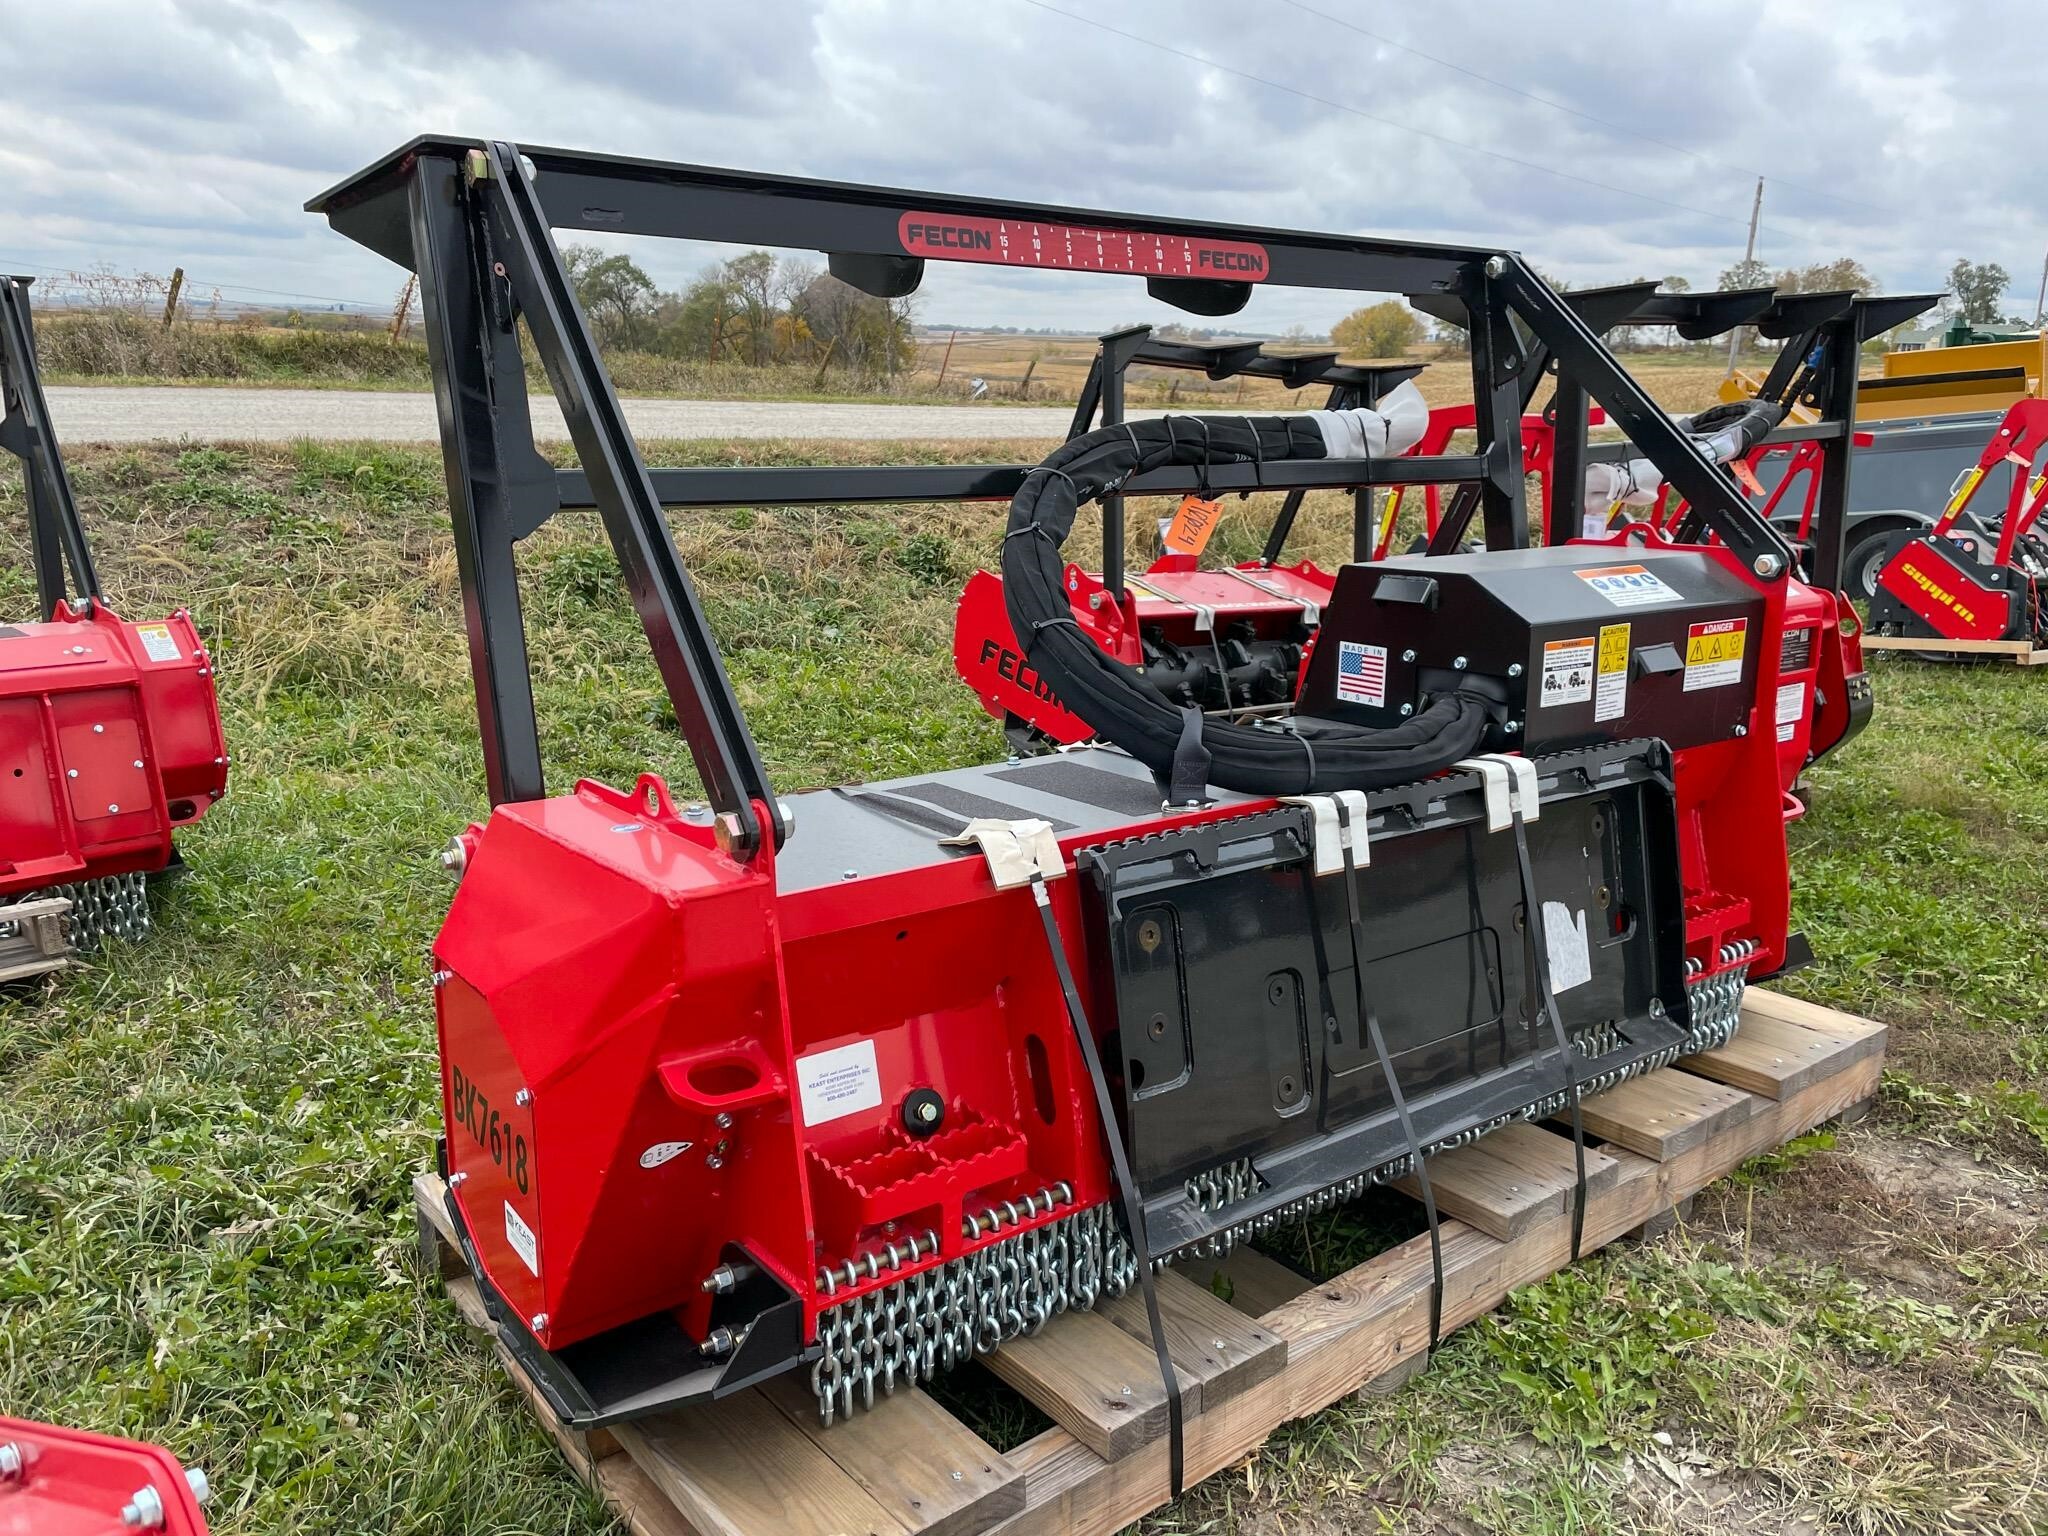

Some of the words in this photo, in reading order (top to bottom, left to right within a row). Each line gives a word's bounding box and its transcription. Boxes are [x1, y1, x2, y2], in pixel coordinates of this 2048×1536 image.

[907, 223, 992, 250] FECON
[1000, 235, 1009, 247] 15
[1032, 238, 1041, 250] 10
[1066, 241, 1072, 252] 5
[1097, 244, 1103, 255] 0
[1127, 246, 1133, 257] 5
[1155, 249, 1164, 260] 10
[1183, 251, 1192, 262] 15
[1198, 249, 1263, 272] FECON
[1901, 562, 1956, 606] seppi
[1606, 626, 1629, 635] CAUTION
[1708, 622, 1734, 633] DANGER
[1344, 643, 1369, 654] MADE
[808, 1080, 826, 1089] KEAST
[826, 1070, 862, 1085] ENTERPRISES
[453, 1063, 529, 1196] BK7618
[514, 1219, 535, 1249] KEAST
